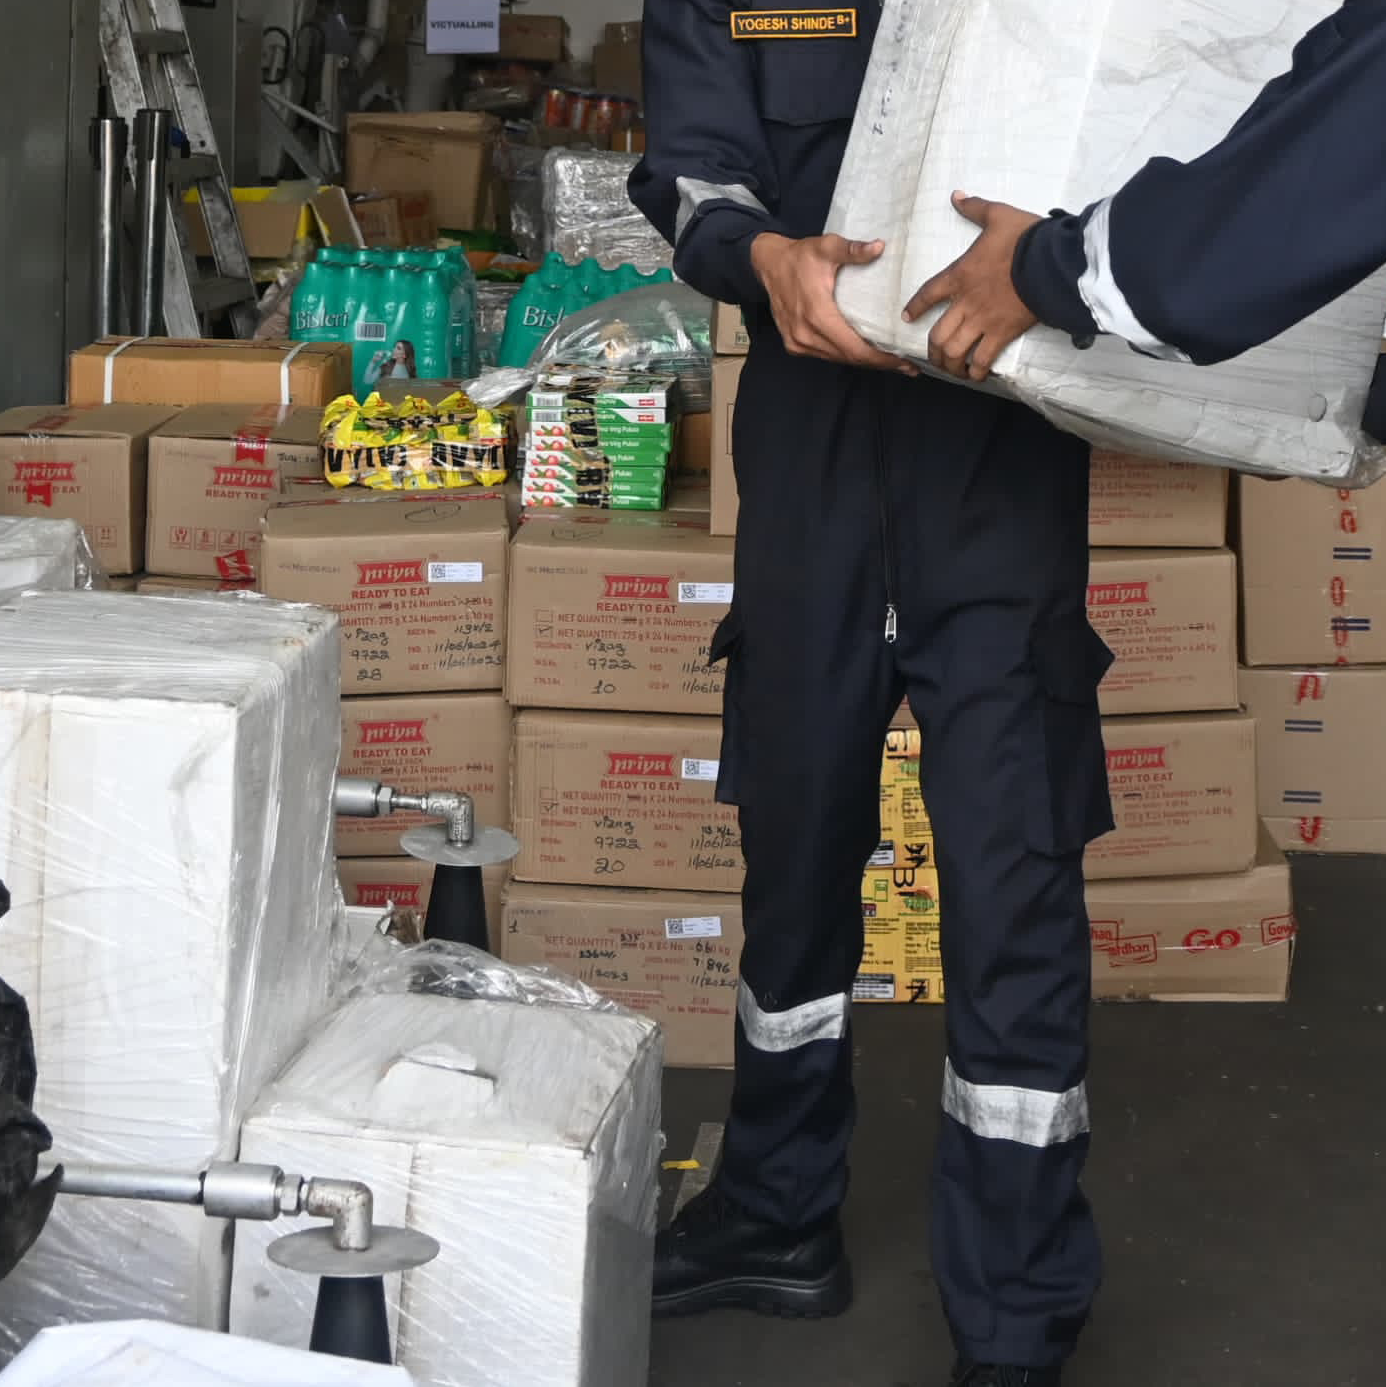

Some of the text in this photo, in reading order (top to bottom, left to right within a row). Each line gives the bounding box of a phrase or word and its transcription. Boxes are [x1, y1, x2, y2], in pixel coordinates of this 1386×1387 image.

[430, 20, 494, 30] VICTUALLING
[737, 14, 850, 31] YOGESH SHINDE B+
[294, 310, 350, 329] Bisleri
[19, 464, 69, 479] priya
[218, 469, 268, 485] priya
[205, 488, 242, 499] READY
[244, 491, 260, 500] TO
[365, 563, 416, 583] priya
[352, 587, 431, 599] READY TO EAT
[610, 578, 664, 597] priya
[1093, 585, 1142, 603] priya
[597, 602, 677, 614] READY TO EAT
[1088, 607, 1157, 620] EADY TO EAT
[558, 614, 575, 623] NET
[664, 618, 702, 628] Numbers
[557, 629, 575, 638] NET
[664, 632, 702, 644] Numbers
[366, 722, 417, 742] priya
[353, 747, 432, 759] READY TO EAT
[1110, 750, 1159, 769] priya
[612, 756, 667, 776] priya
[1137, 774, 1151, 783] TO
[1153, 771, 1174, 782] EAT
[600, 780, 682, 791] READY TO EAT
[362, 885, 412, 903] priya
[545, 935, 565, 945] NET
[1184, 928, 1241, 953] GO
